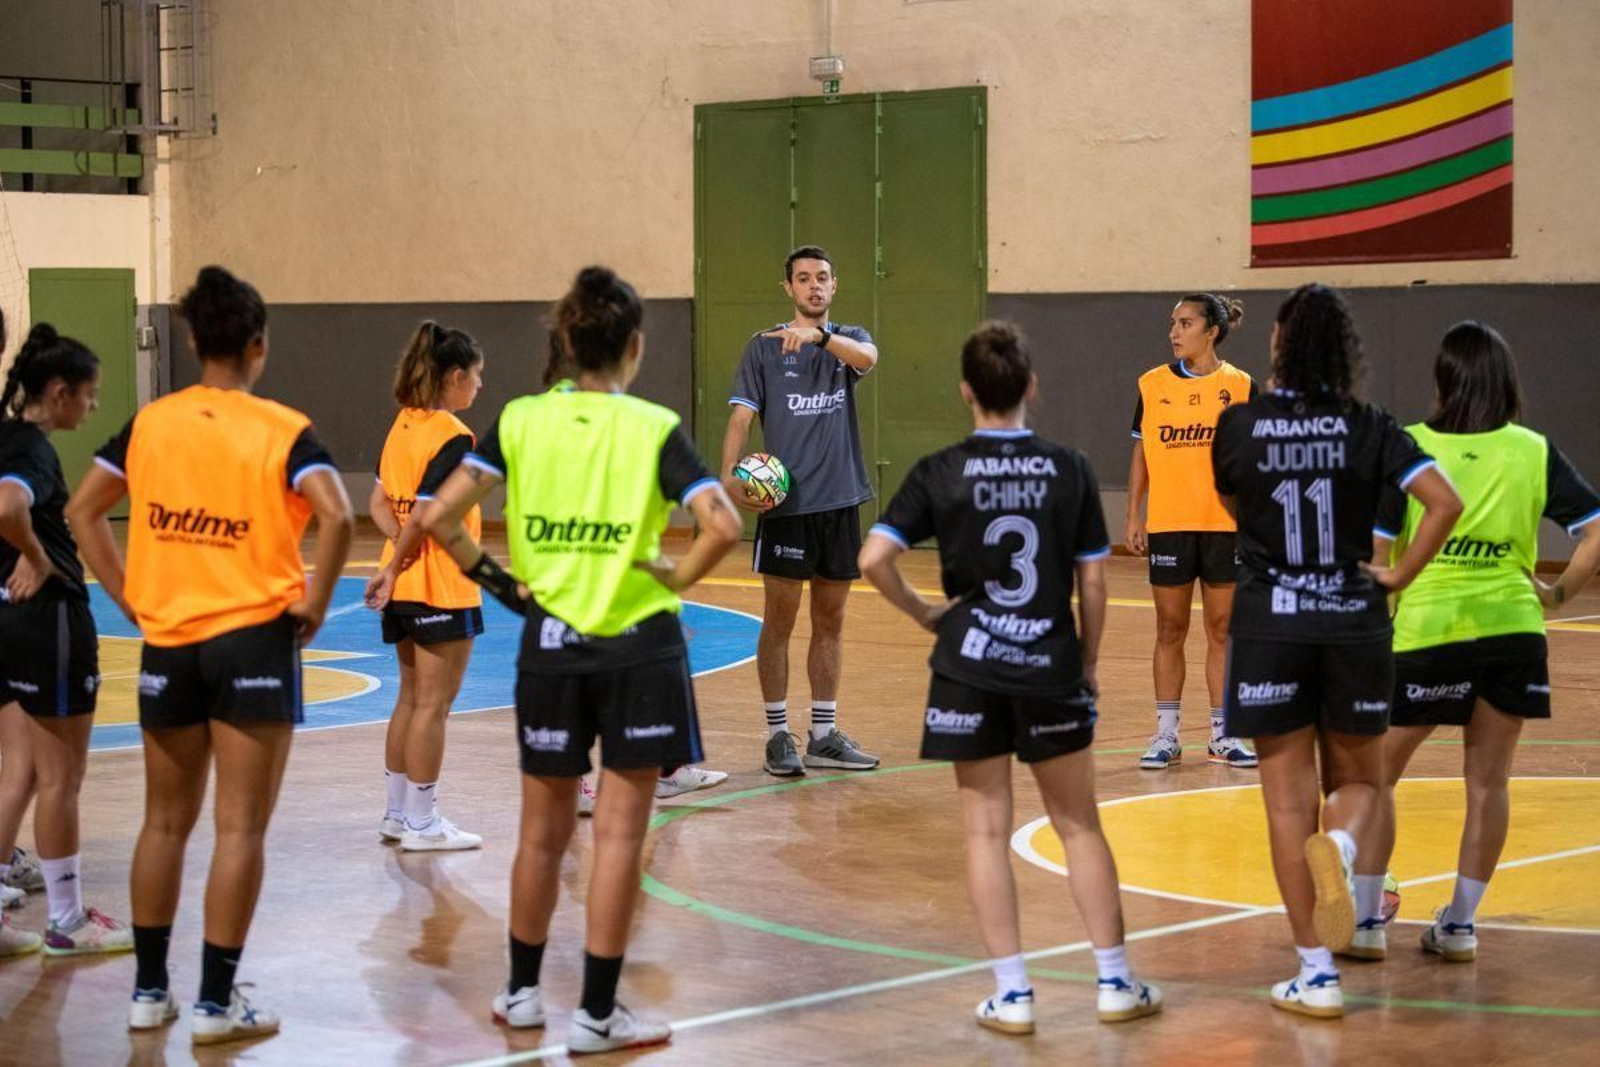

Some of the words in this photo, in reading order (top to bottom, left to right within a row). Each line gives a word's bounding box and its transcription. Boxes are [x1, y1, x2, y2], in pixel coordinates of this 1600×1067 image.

[786, 388, 845, 410] Ontime
[1188, 394, 1201, 406] 21
[1158, 423, 1217, 443] Ontim
[1257, 441, 1346, 473] JUDITH
[973, 479, 1048, 512] CHIKY
[147, 501, 252, 541] Ontime
[525, 514, 632, 544] Ontime
[1271, 477, 1335, 566] 11
[1442, 534, 1514, 559] time
[983, 514, 1039, 608] 3
[1237, 682, 1298, 701] Ontime
[925, 707, 984, 728] Ontime
